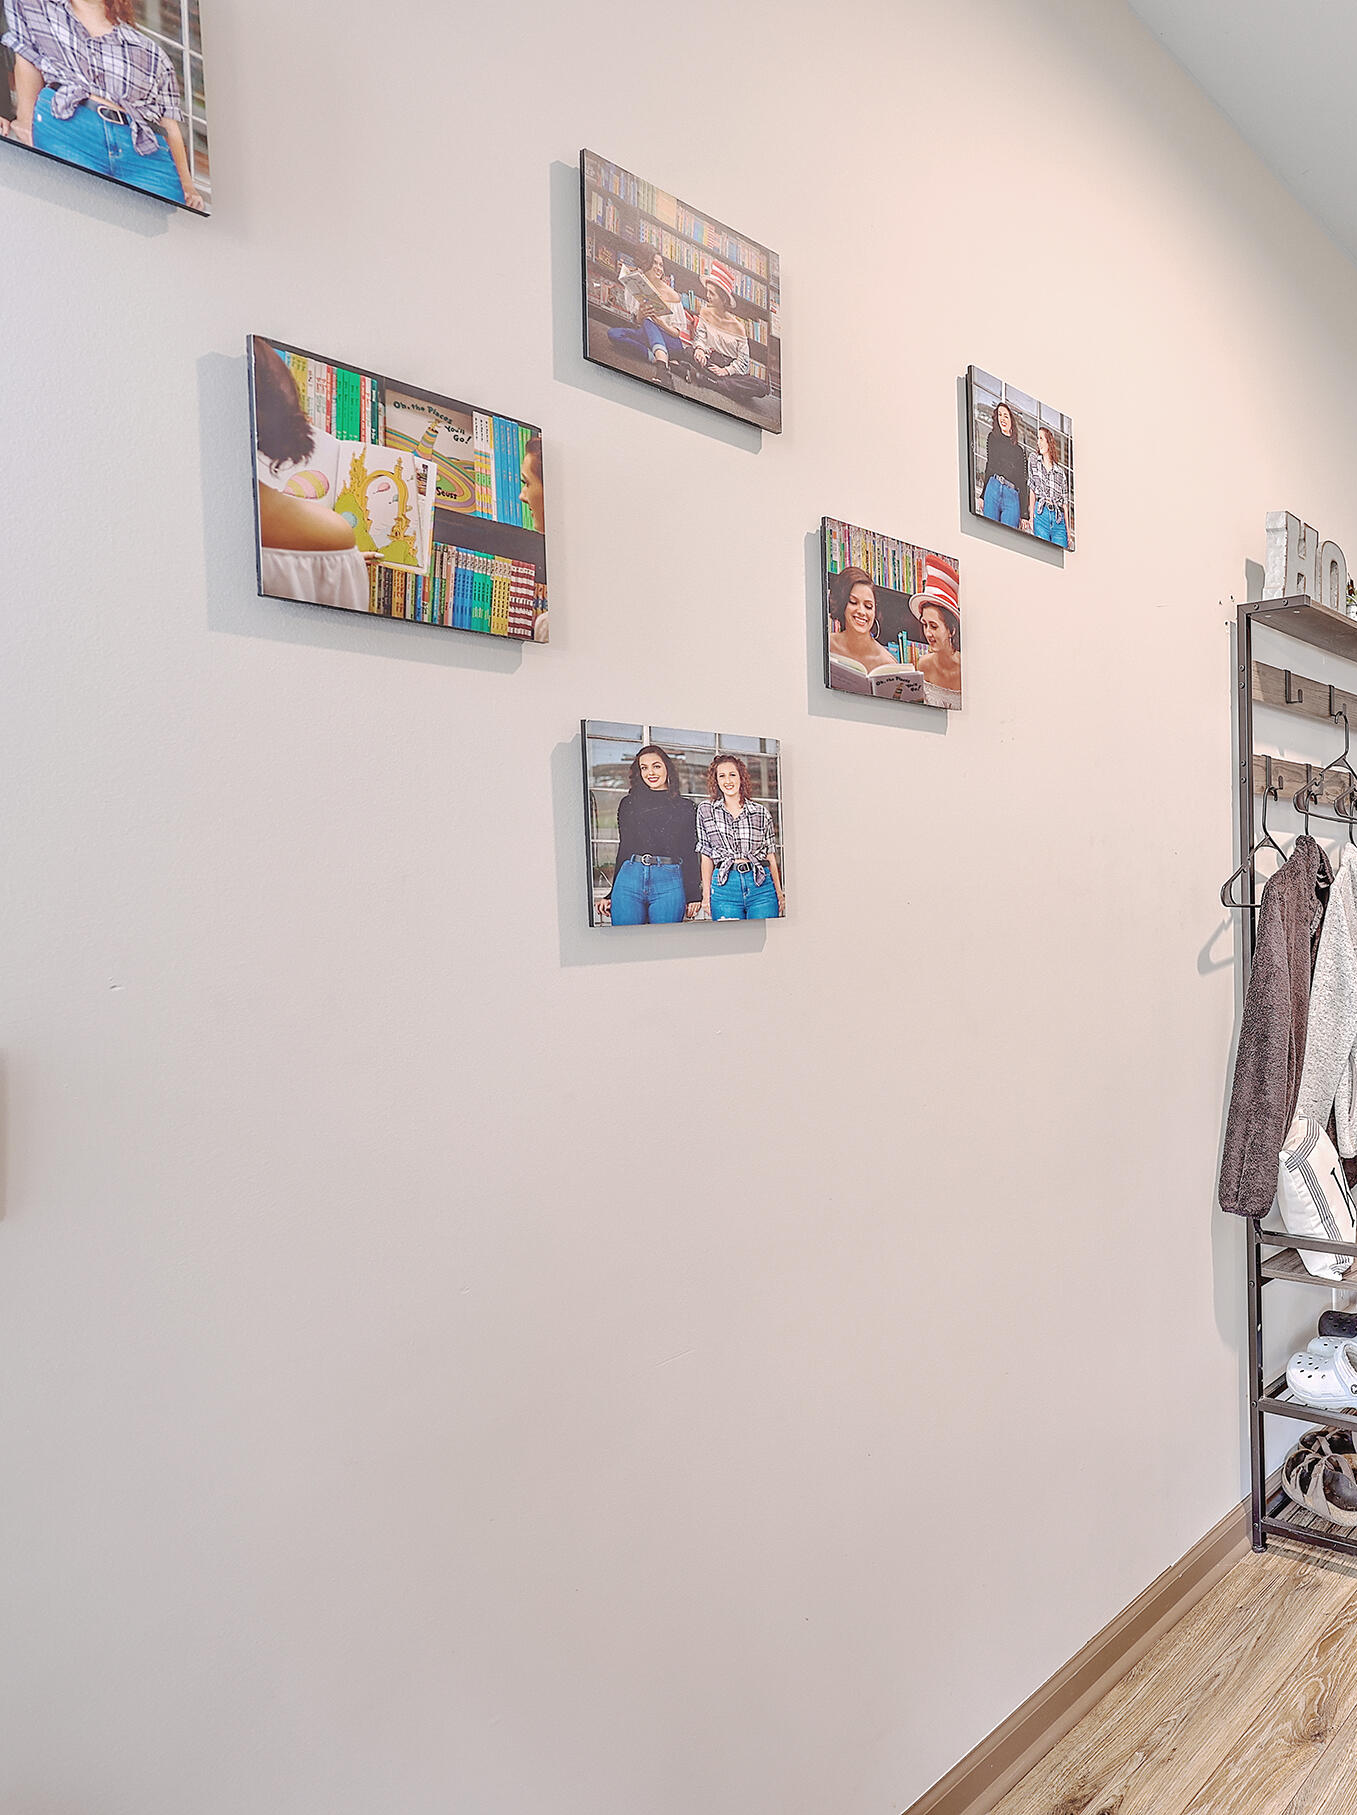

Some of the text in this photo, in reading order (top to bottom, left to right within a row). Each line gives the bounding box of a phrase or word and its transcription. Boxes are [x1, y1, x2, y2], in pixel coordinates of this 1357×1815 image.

[411, 403, 426, 413] the
[427, 405, 453, 424] Places
[453, 435, 472, 444] Go!
[435, 487, 458, 500] Seuss
